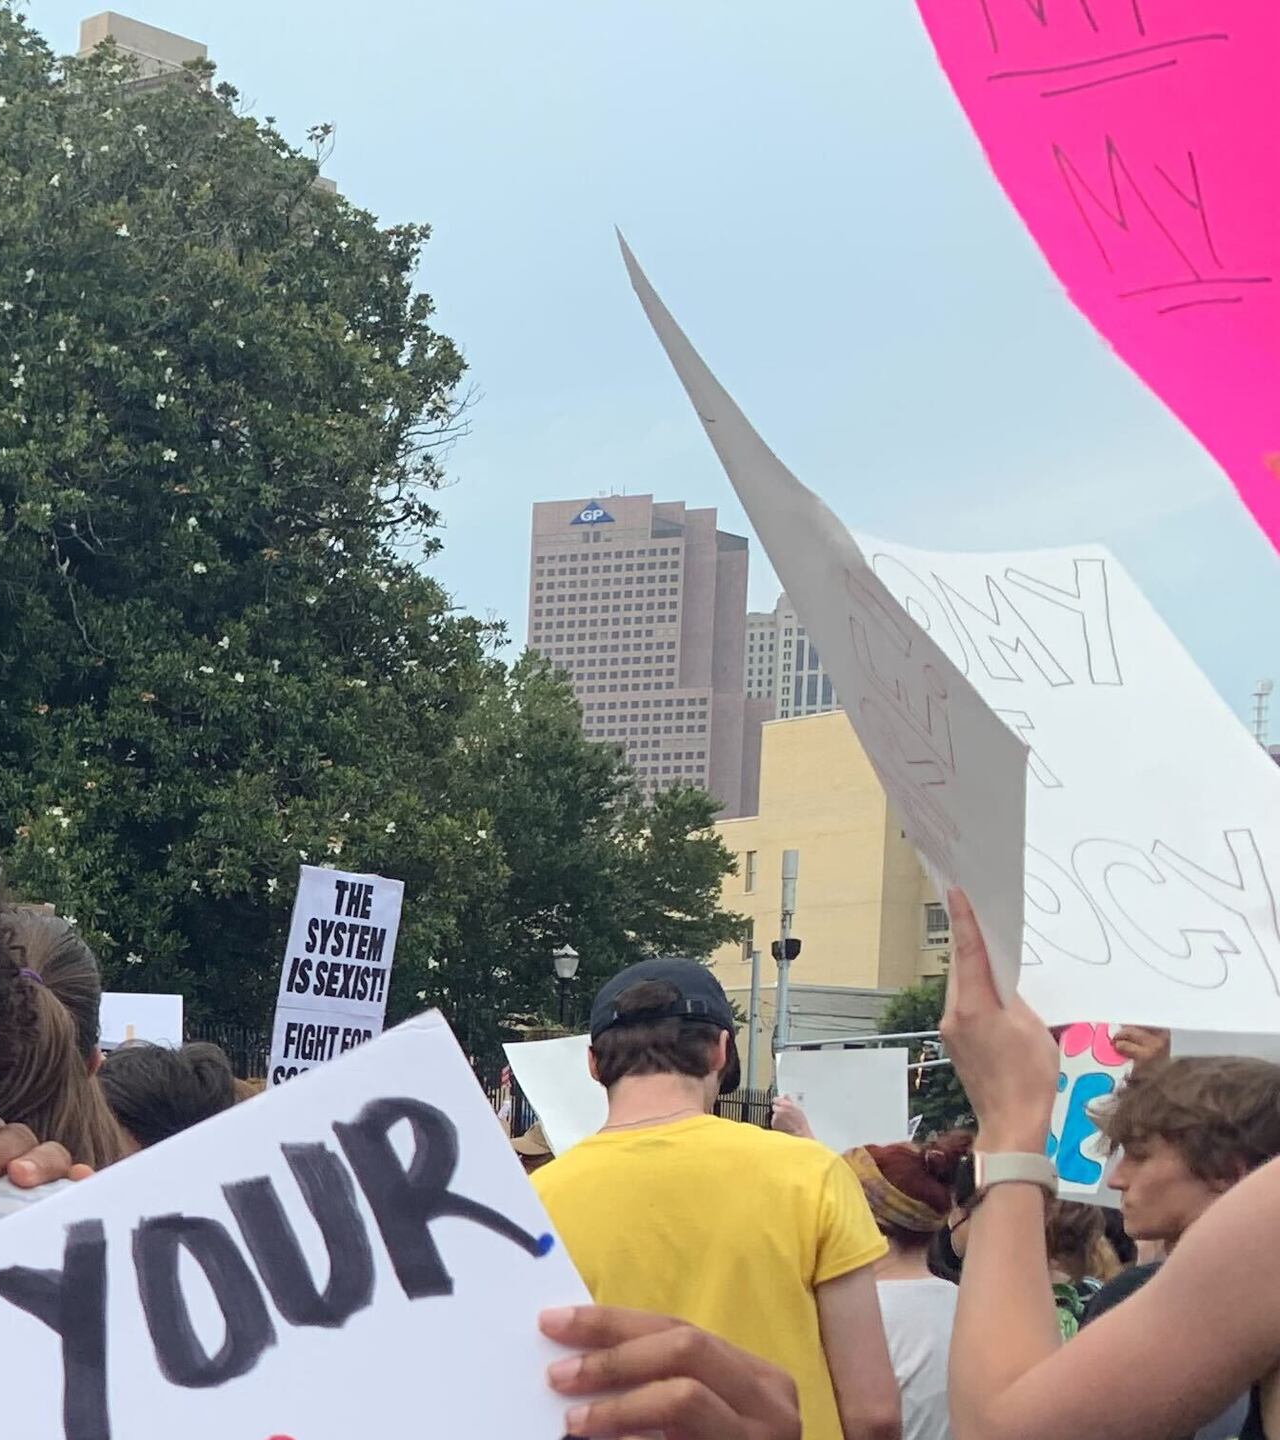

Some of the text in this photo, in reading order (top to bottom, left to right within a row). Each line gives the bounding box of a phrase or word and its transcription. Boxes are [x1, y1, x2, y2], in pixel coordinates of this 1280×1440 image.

[1051, 133, 1224, 282] MY
[579, 509, 605, 523] GP
[334, 879, 375, 920] THE
[304, 917, 388, 963] SYSTEM
[286, 957, 387, 1003] IS SEXIST!
[283, 1021, 340, 1062] FIGHT
